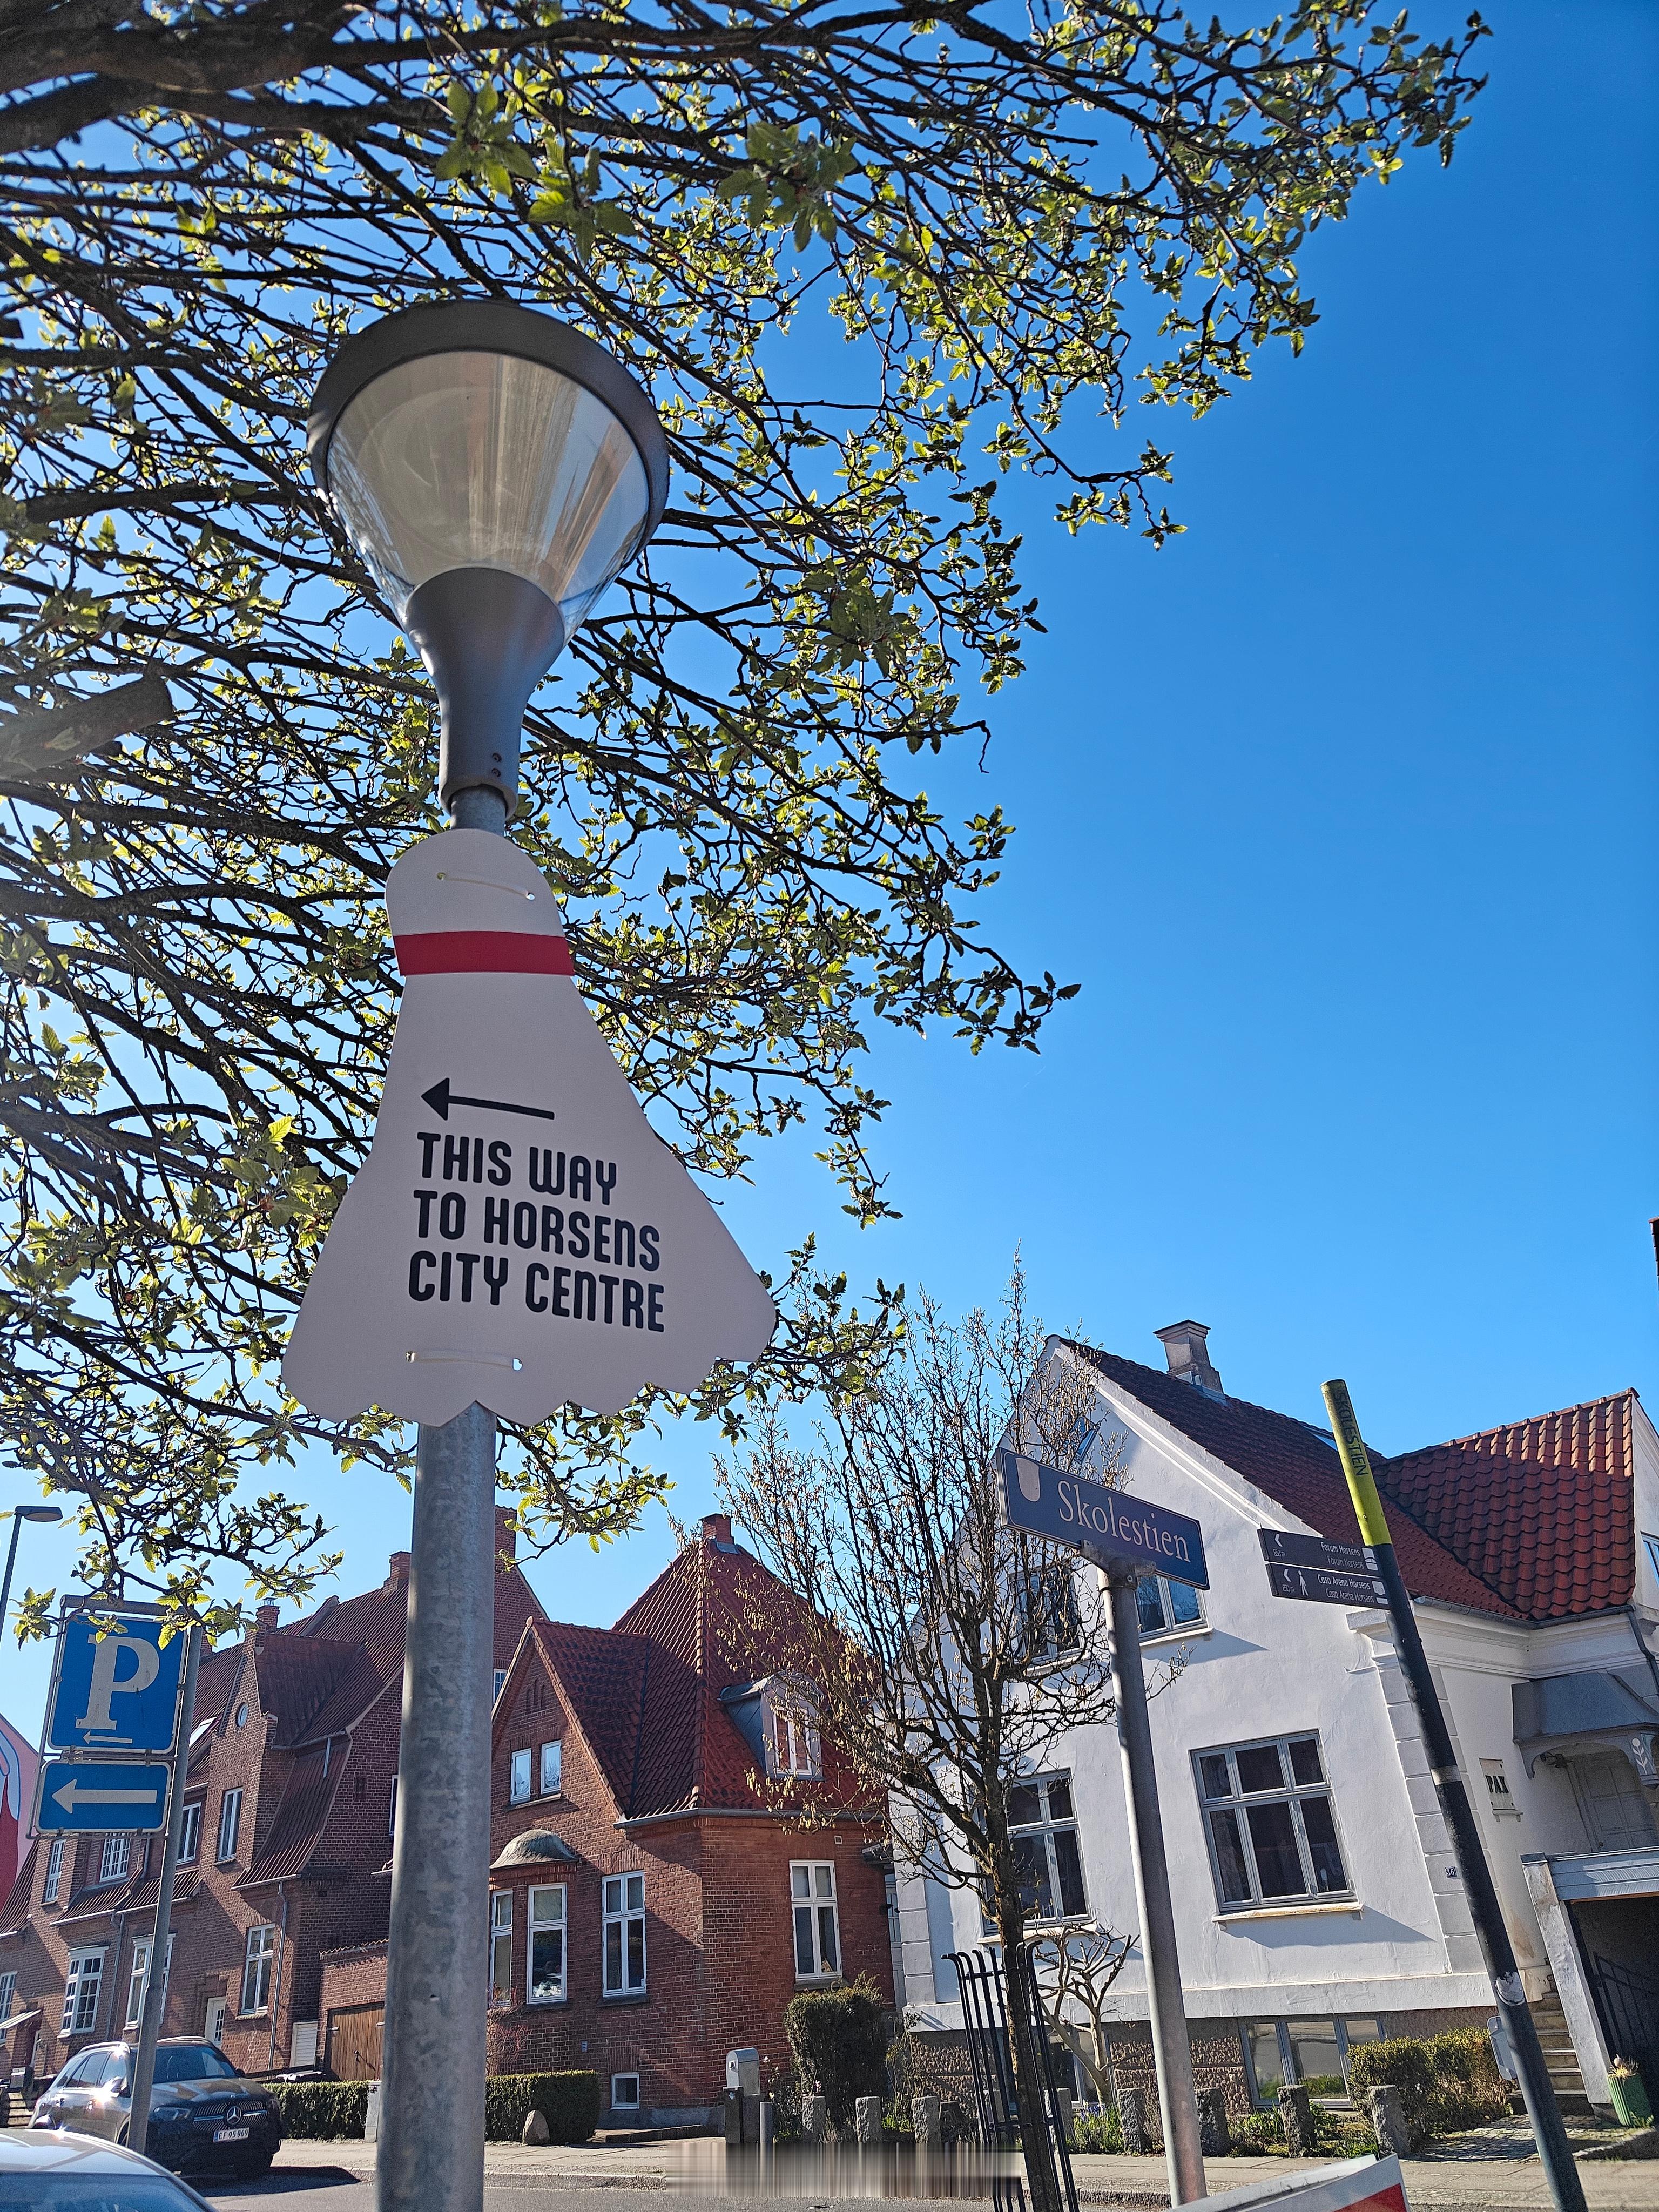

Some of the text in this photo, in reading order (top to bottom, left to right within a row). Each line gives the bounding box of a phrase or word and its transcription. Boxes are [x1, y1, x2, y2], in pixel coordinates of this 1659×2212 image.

[417, 1132, 617, 1205] THIS WAY
[413, 1190, 660, 1272] TO HORSENS
[408, 1250, 665, 1333] CITY CENTRE
[1333, 1393, 1369, 1476] SKOLESTIEN
[1057, 1480, 1191, 1563] Skolestien
[1320, 1542, 1360, 1556] Forum Horsens
[1327, 1555, 1364, 1569] Forum Horsens
[1317, 1574, 1371, 1590] Casa Arena Horsens
[1325, 1588, 1374, 1603] Casa Arena Horsens
[75, 1634, 160, 1730] P
[1485, 1775, 1509, 1793] PAX
[1446, 1868, 1455, 1876] 36
